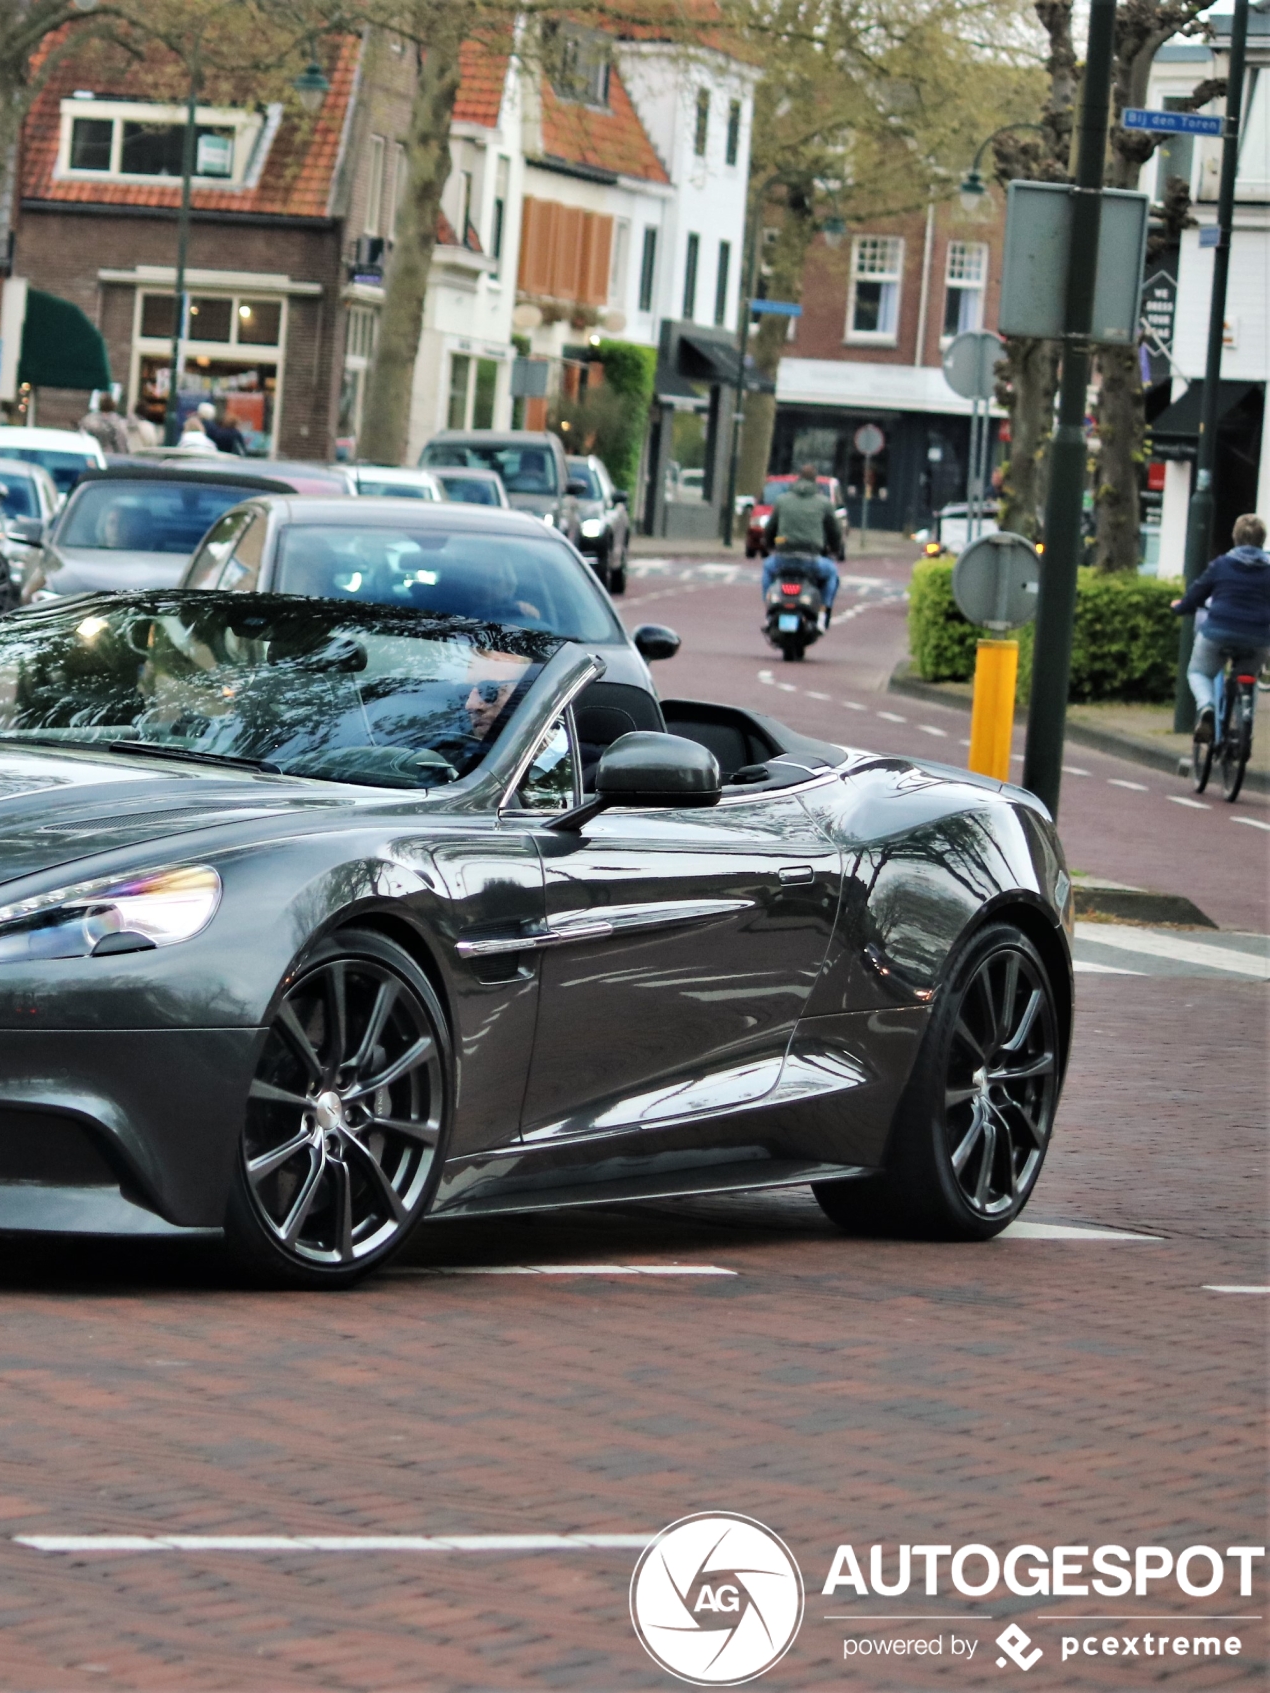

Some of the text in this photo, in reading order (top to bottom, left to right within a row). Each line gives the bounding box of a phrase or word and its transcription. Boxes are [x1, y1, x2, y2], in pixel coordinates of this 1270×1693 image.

[1128, 111, 1217, 129] Bij den Toren
